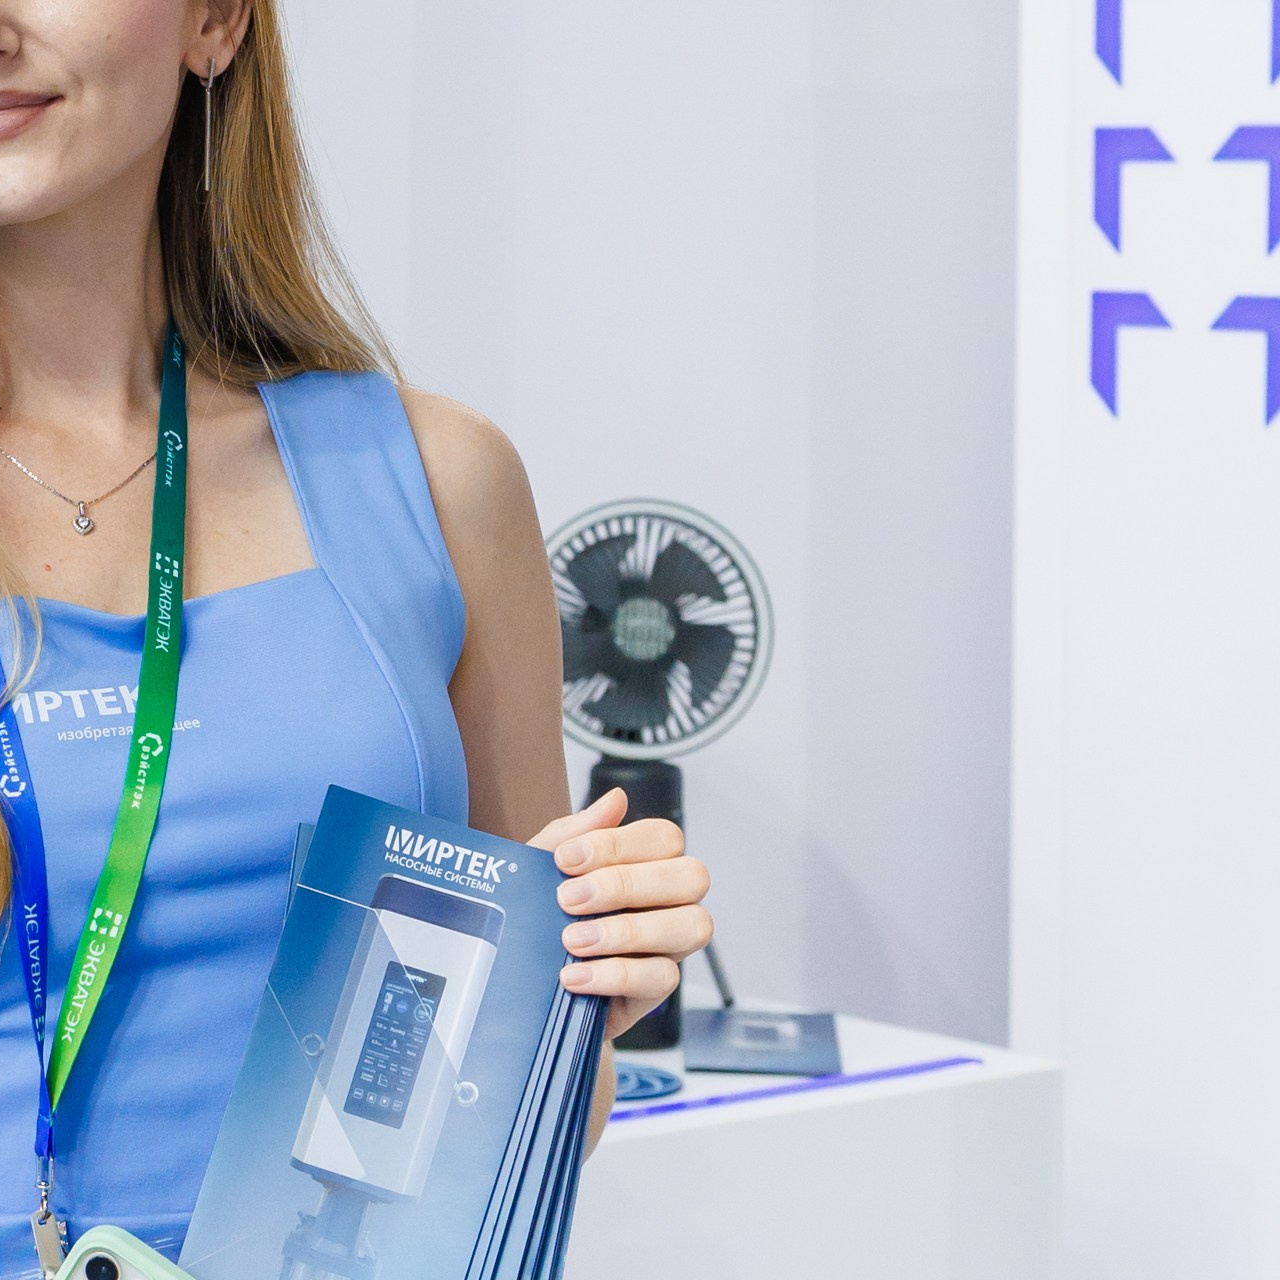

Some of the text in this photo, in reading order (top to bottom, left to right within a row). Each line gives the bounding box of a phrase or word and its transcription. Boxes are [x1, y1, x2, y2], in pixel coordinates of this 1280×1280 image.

[155, 576, 173, 653] ЭКВАТЭК
[57, 725, 134, 742] изобретая
[131, 745, 151, 810] ВЭЙСТТЭК
[384, 852, 496, 894] НАСОСНЫЕ СИСТЕМЫ
[24, 903, 43, 1009] ЭКВАТЭК
[61, 939, 106, 1044] ЭКВАТЭК
